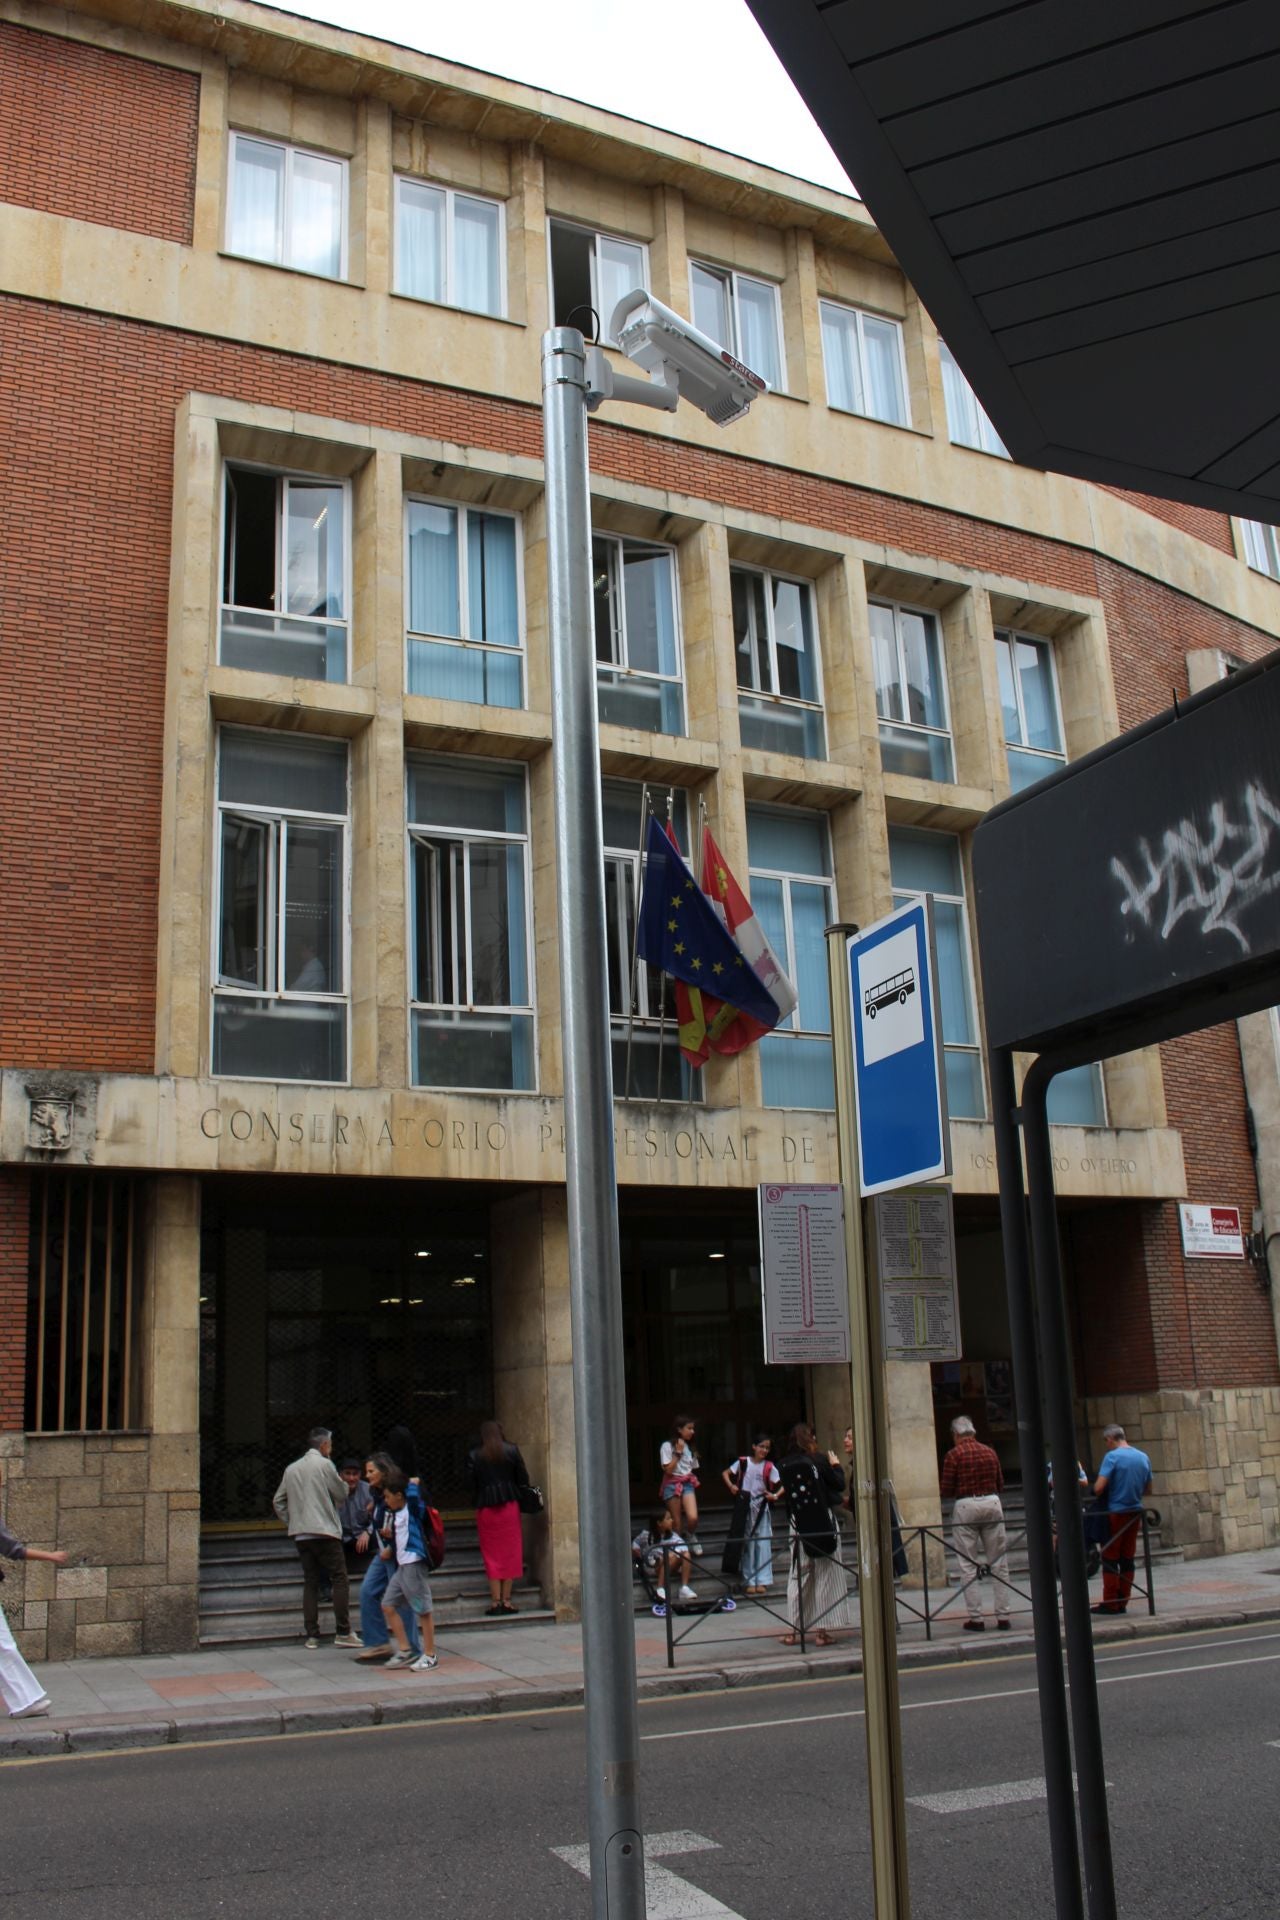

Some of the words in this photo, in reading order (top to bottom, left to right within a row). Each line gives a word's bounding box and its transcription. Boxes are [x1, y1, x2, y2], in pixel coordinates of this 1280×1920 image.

[200, 1108, 508, 1151] CONSERVATORIO
[540, 1124, 757, 1162] PESIONAL
[782, 1136, 816, 1163] DE
[1080, 1157, 1137, 1174] OVEJERO
[771, 1189, 778, 1199] 3
